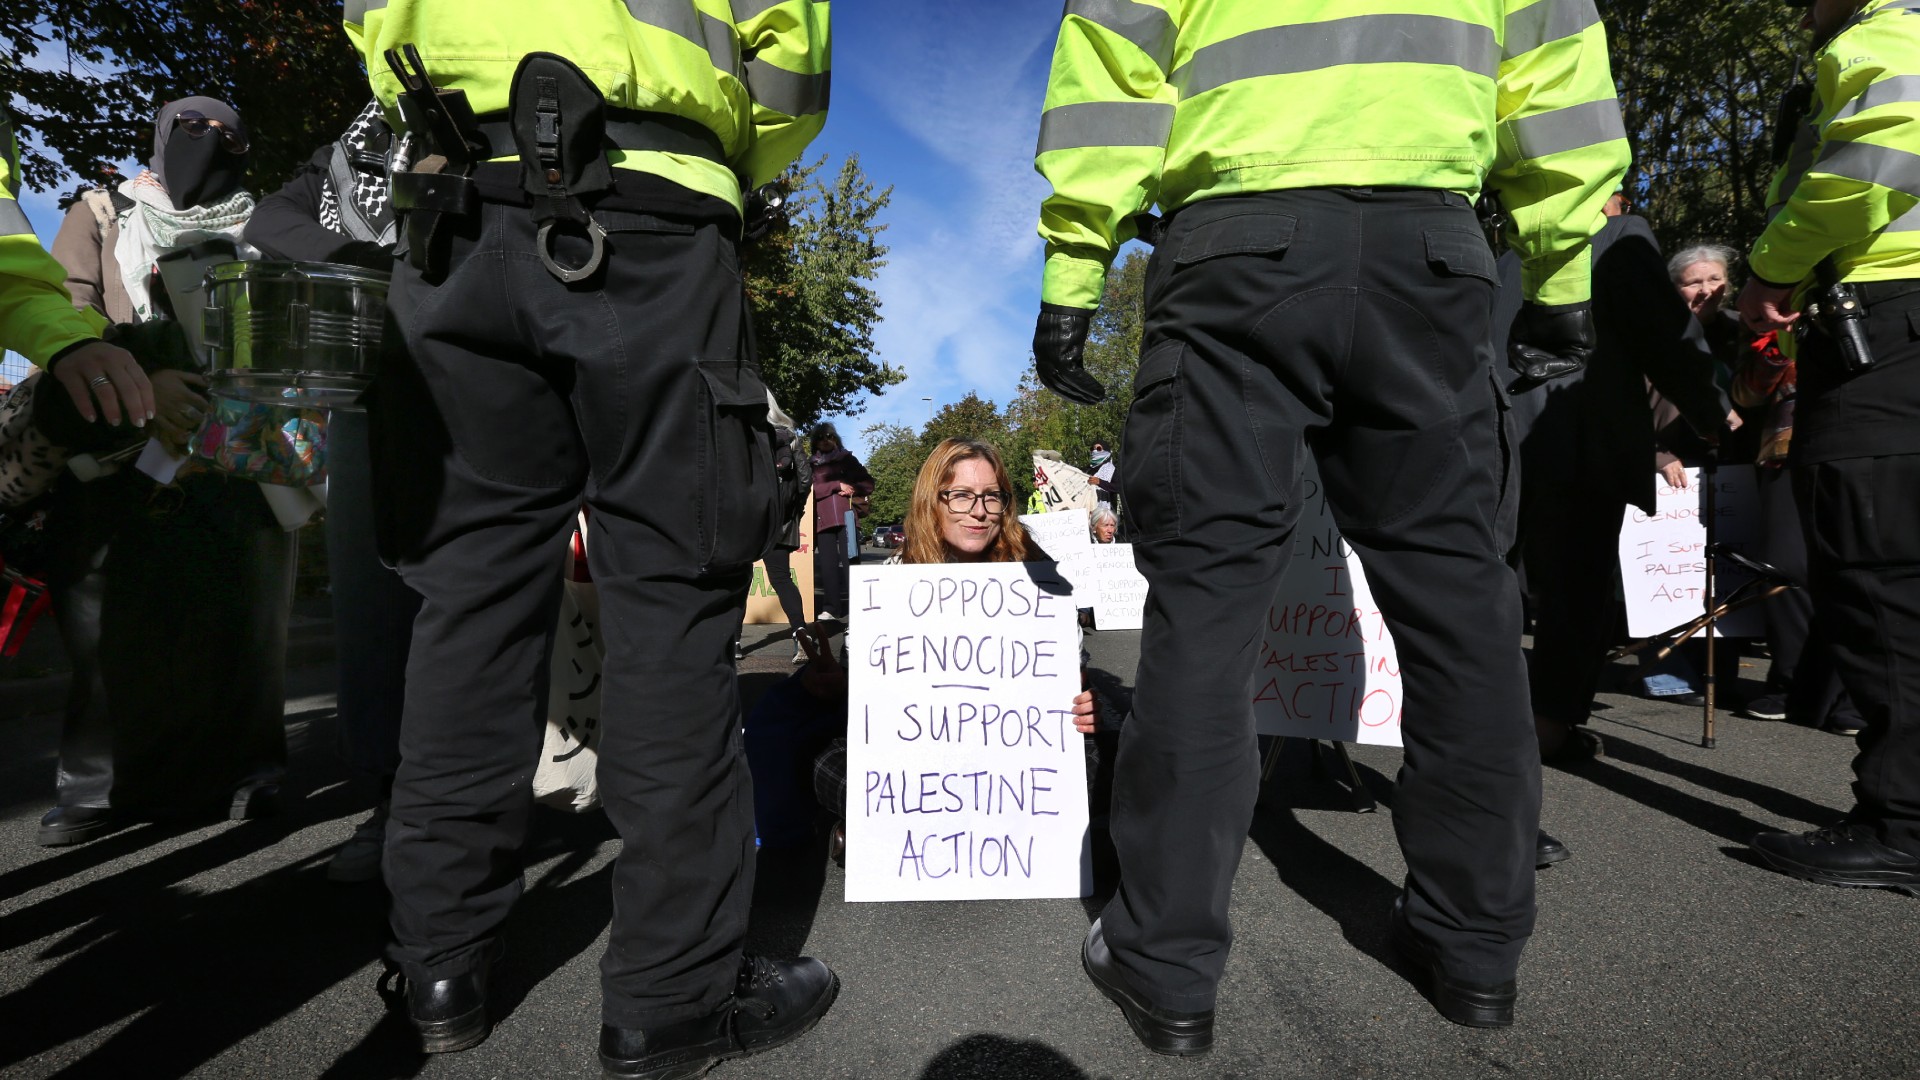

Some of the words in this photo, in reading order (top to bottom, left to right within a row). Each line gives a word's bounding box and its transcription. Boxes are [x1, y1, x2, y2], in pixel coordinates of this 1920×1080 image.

[1092, 547, 1098, 559] I
[1102, 547, 1133, 558] OPPOS
[1096, 561, 1136, 573] GENOCID
[1636, 540, 1655, 560] I
[862, 579, 881, 611] I
[909, 578, 1060, 618] OPPOSE
[1097, 579, 1103, 591] I
[1107, 579, 1145, 590] SUPPORT
[1324, 566, 1347, 596] I
[1269, 603, 1384, 642] UPPORT
[869, 634, 1058, 679] GENOCIDE
[1261, 640, 1401, 677] ALESTIN
[1253, 677, 1402, 727] ACTIO
[864, 703, 869, 745] I
[897, 702, 1074, 753] SUPPORT
[866, 767, 1060, 818] PALESTINE
[898, 829, 1034, 881] ACTION
